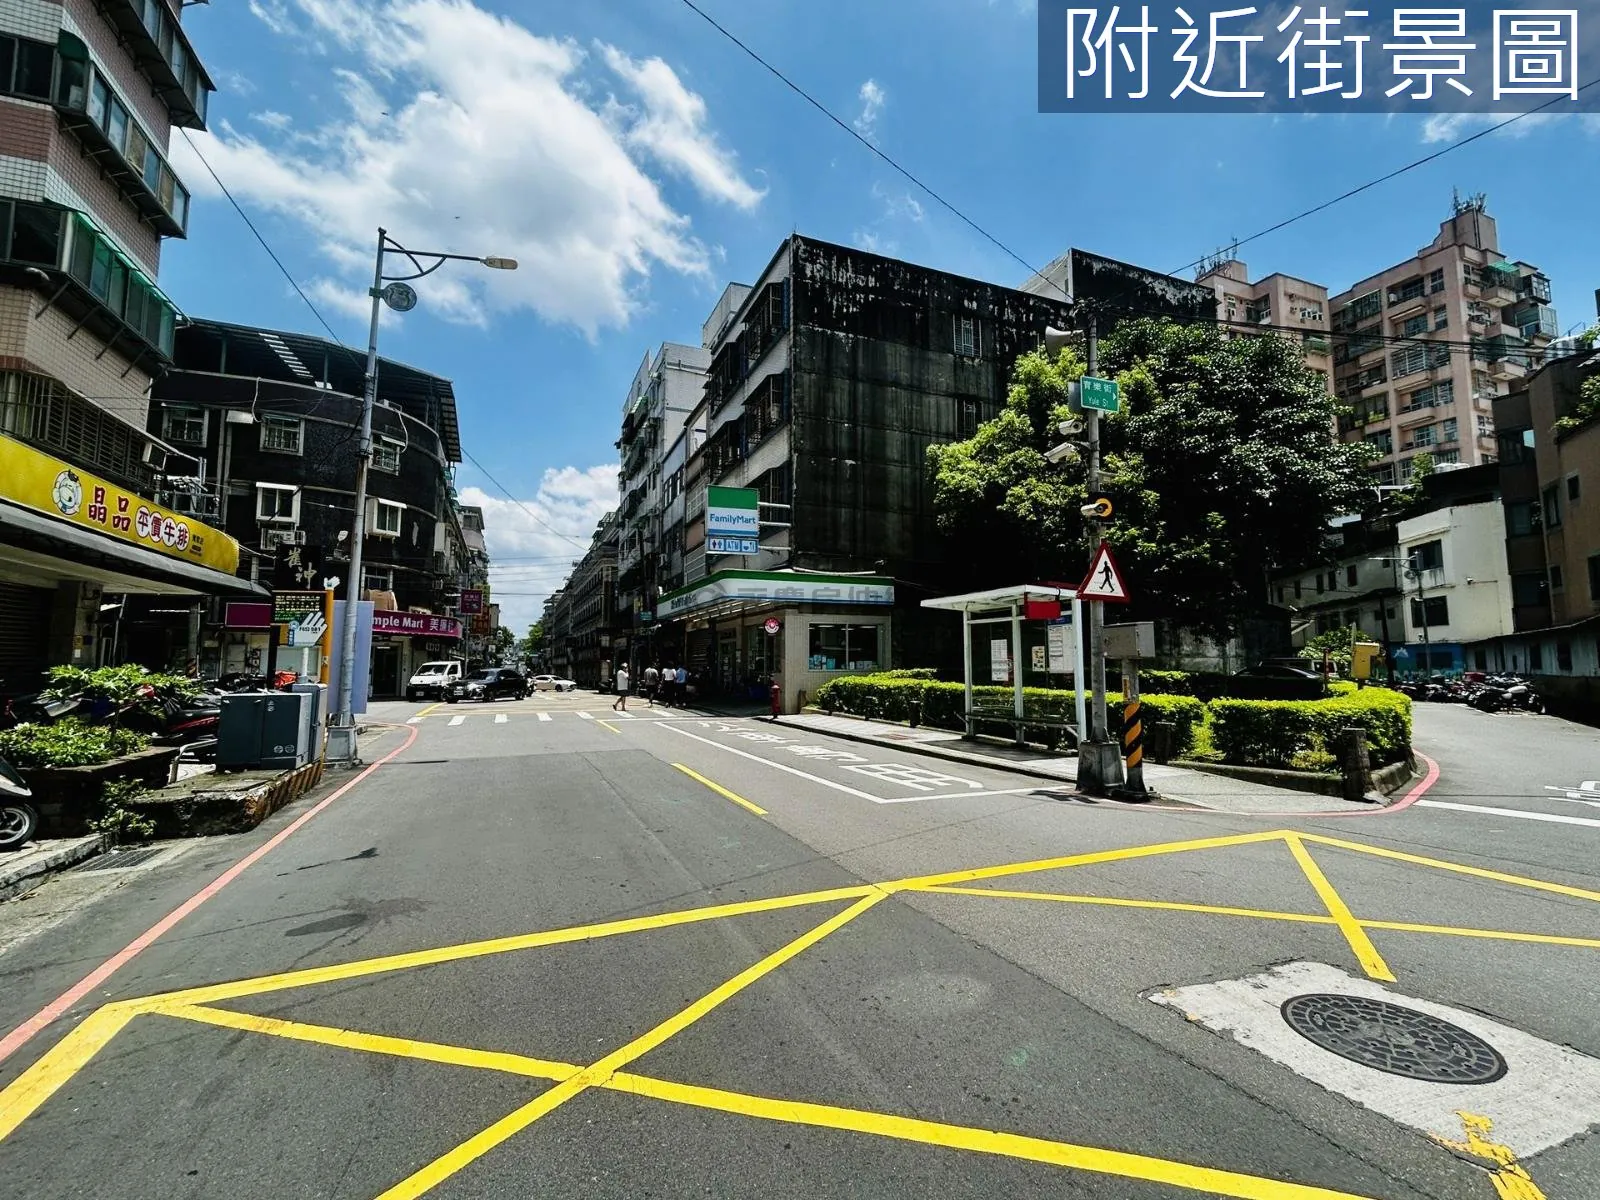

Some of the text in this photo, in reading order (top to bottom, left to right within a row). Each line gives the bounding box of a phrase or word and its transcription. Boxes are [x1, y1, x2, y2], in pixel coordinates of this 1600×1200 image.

[1083, 380, 1112, 393] 育樂街
[88, 485, 189, 548] 晶品 平價牛排
[709, 513, 756, 525] FamilyMart
[726, 540, 740, 552] ATM
[372, 615, 400, 628] mple
[402, 617, 424, 629] Mart
